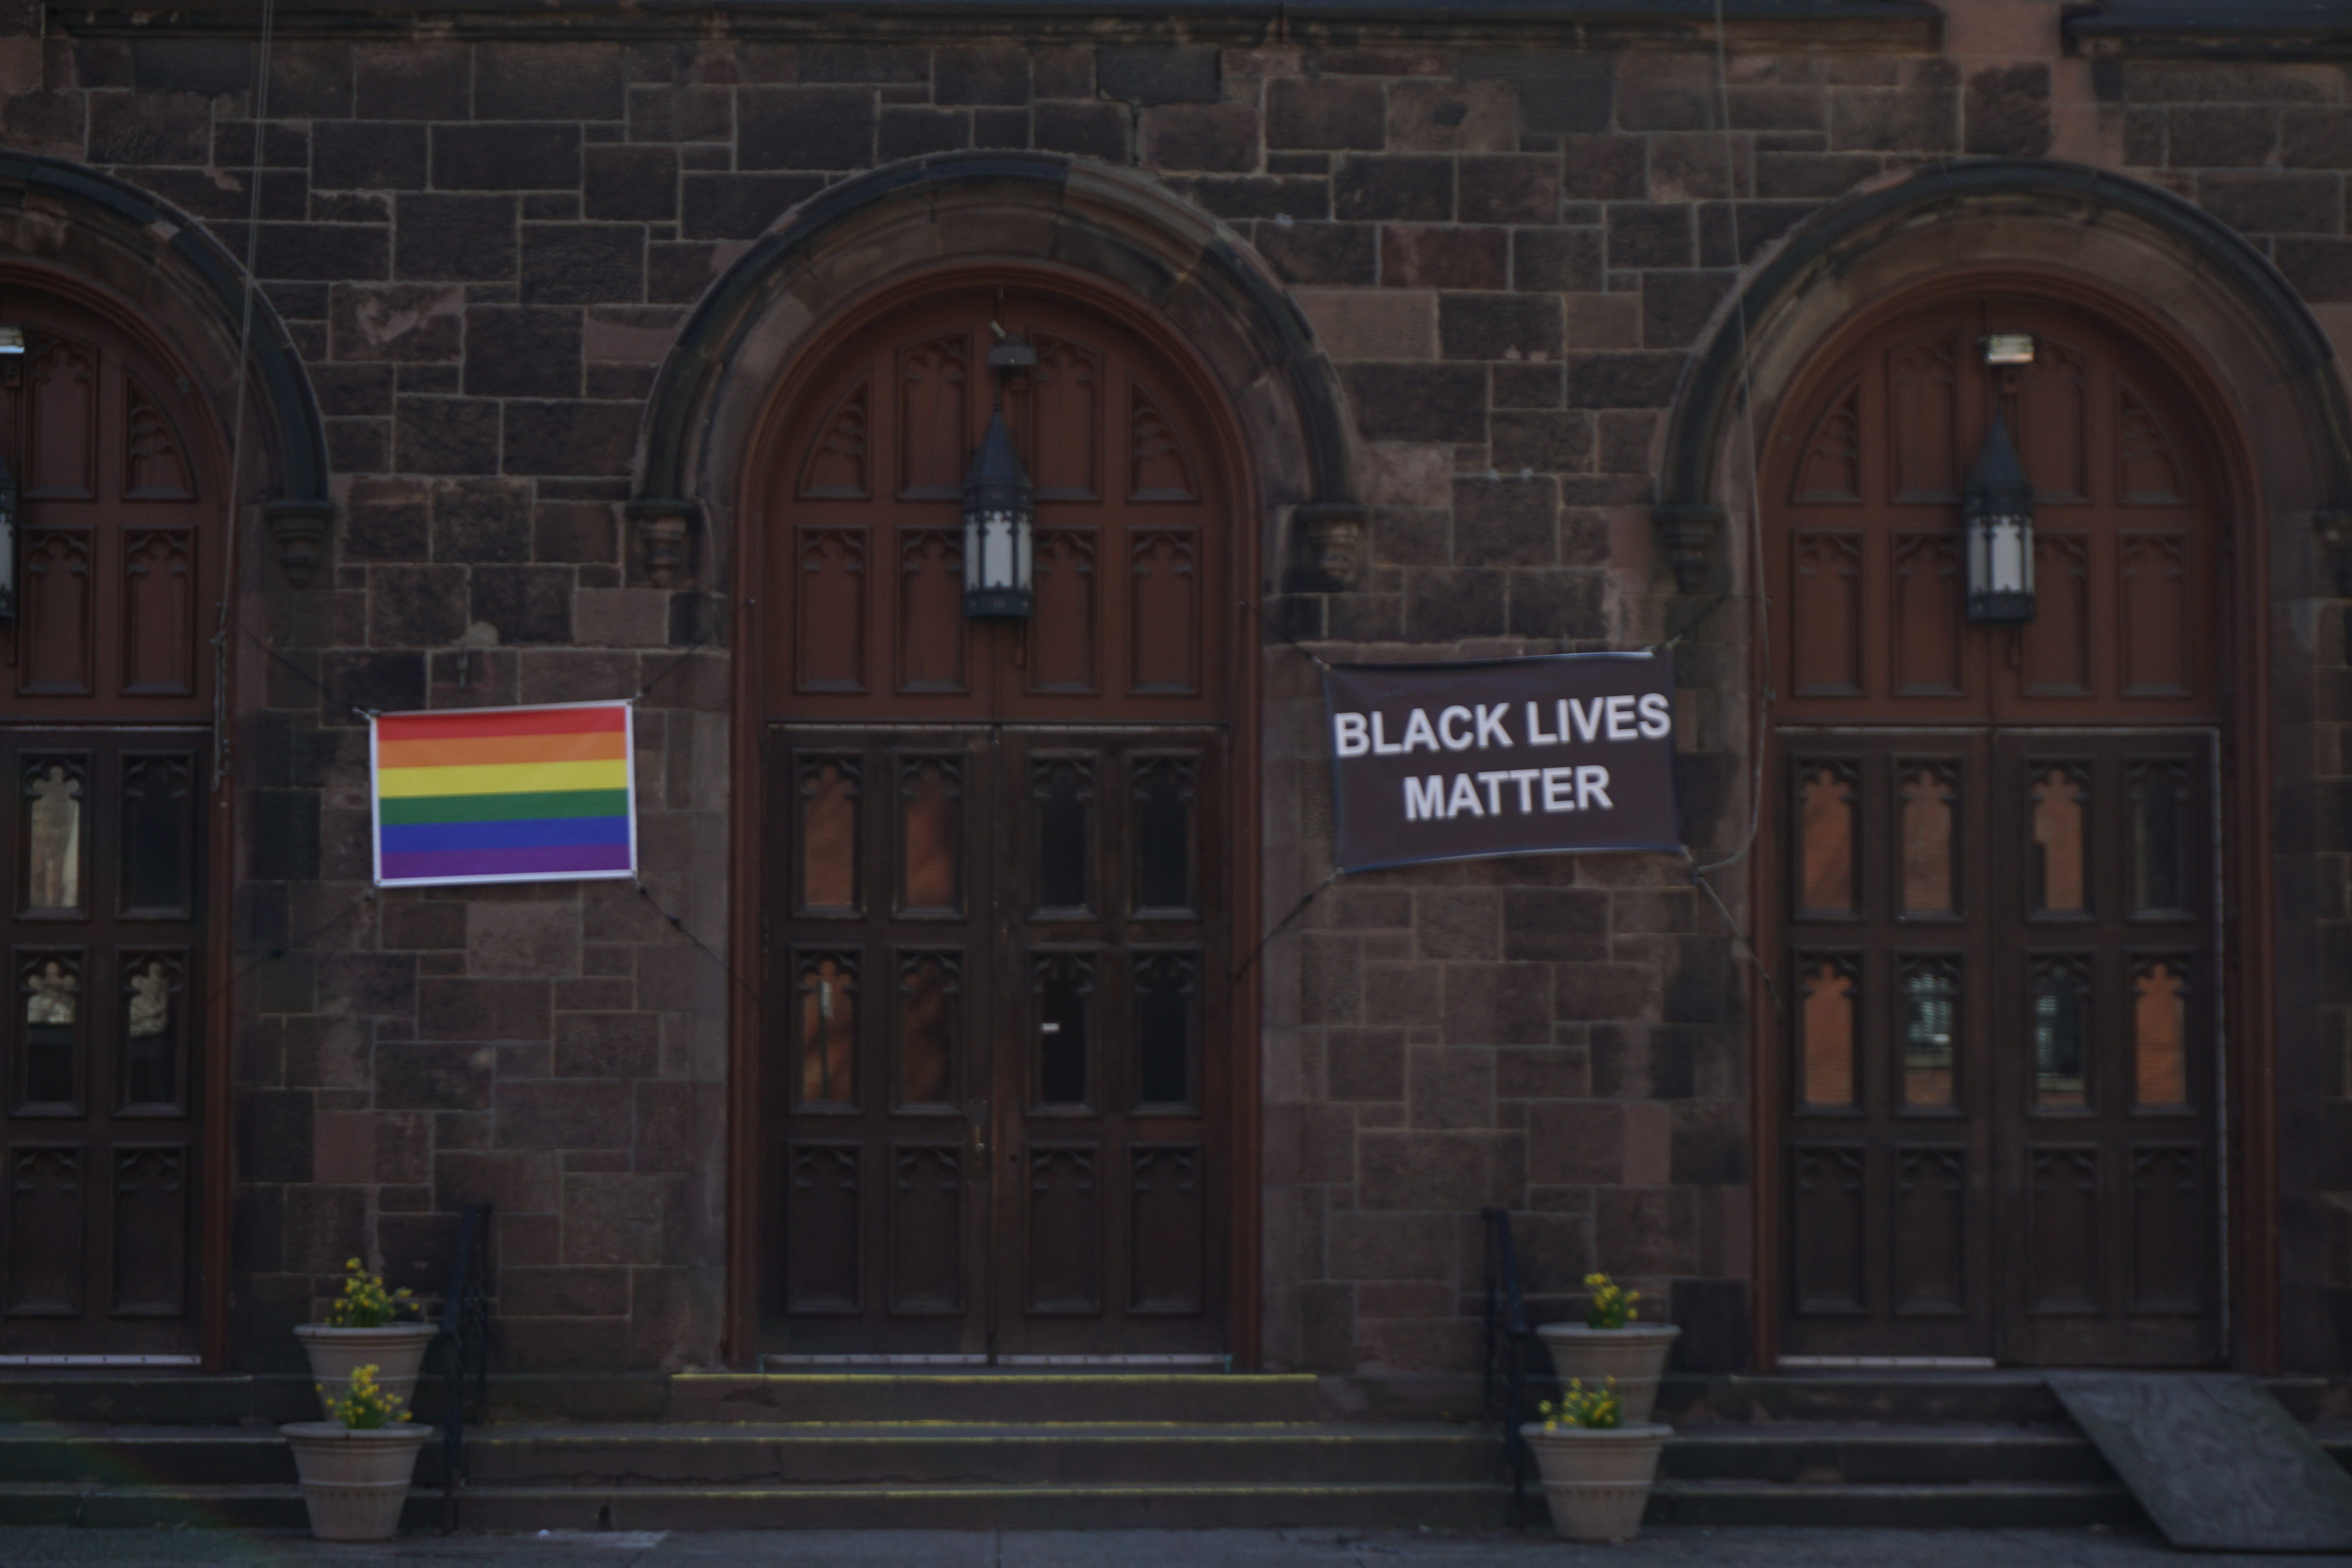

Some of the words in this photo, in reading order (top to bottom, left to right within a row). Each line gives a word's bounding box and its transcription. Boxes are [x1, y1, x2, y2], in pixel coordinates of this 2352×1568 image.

[1334, 702, 1514, 758] BLACK
[1526, 693, 1671, 746] LIVES
[1403, 765, 1613, 821] MATTER
